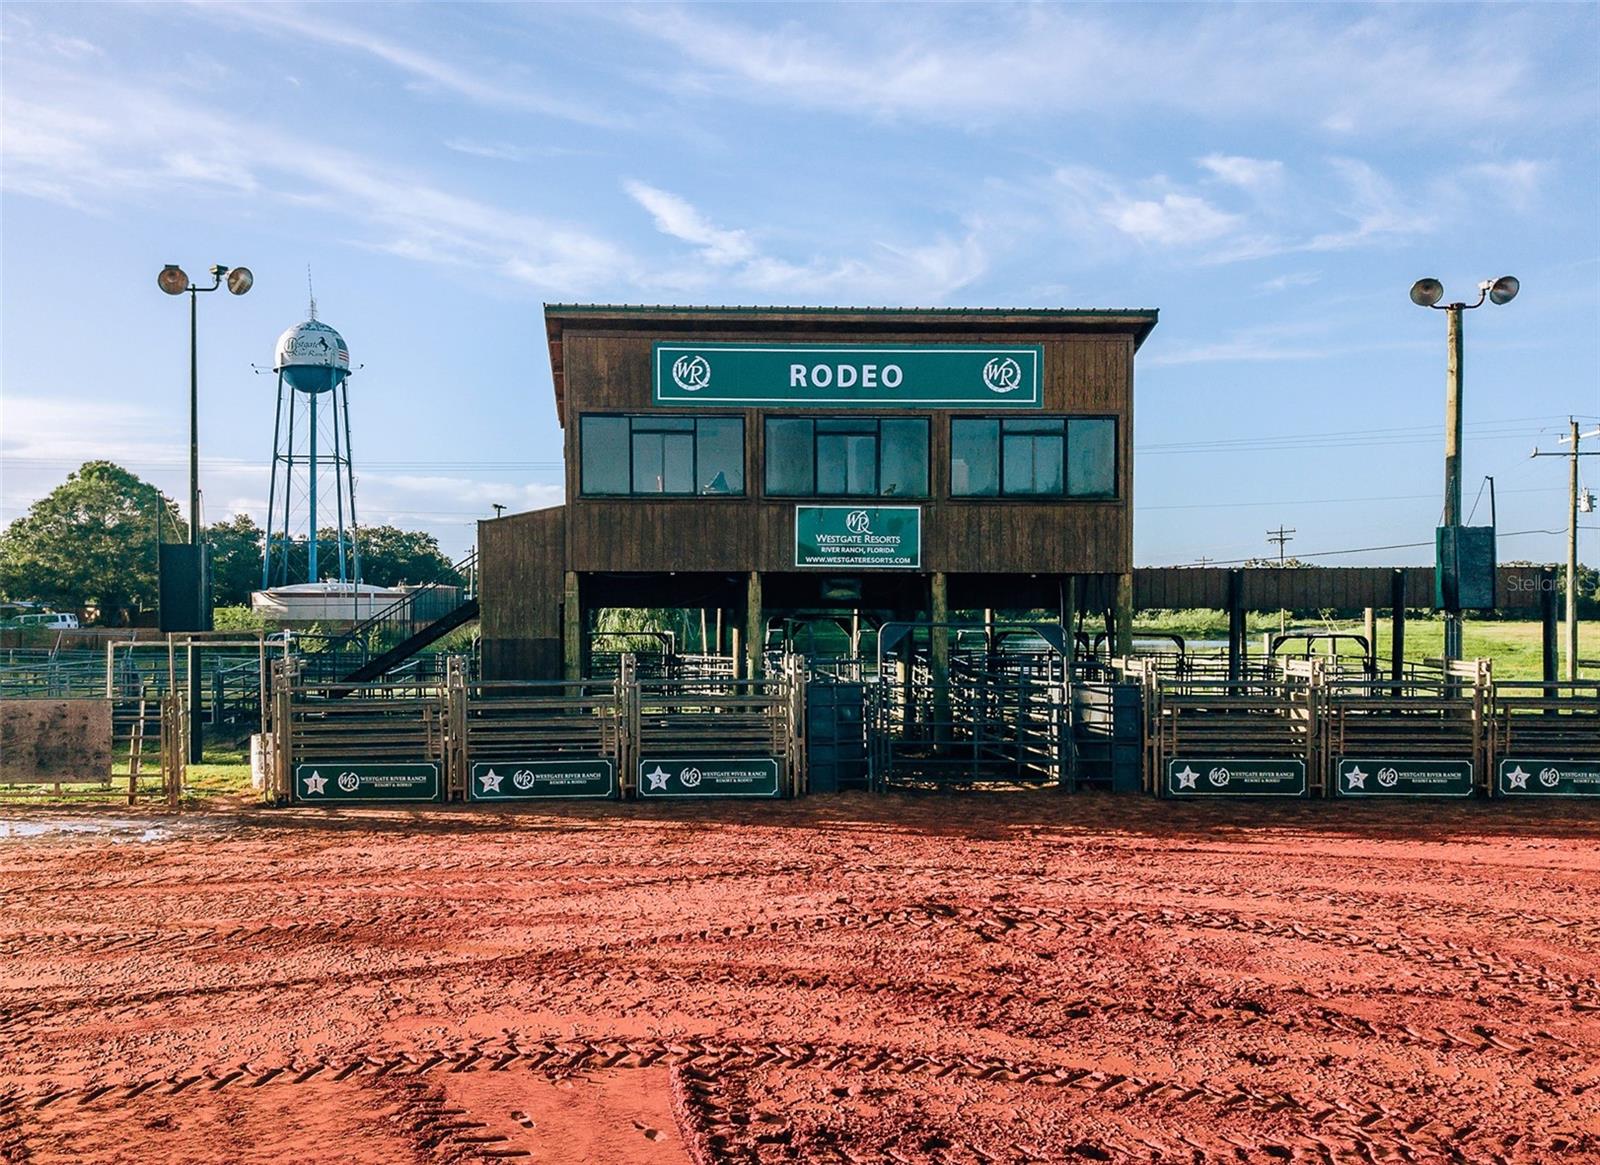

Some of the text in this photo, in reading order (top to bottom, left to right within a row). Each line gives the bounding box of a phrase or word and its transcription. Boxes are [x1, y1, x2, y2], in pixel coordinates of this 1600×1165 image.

[790, 364, 903, 387] RODEO
[488, 776, 495, 786] 2
[655, 774, 662, 784] 3
[1183, 773, 1190, 783] 4
[1353, 773, 1360, 783] 5
[1514, 773, 1522, 783] 6
[313, 779, 318, 789] 1
